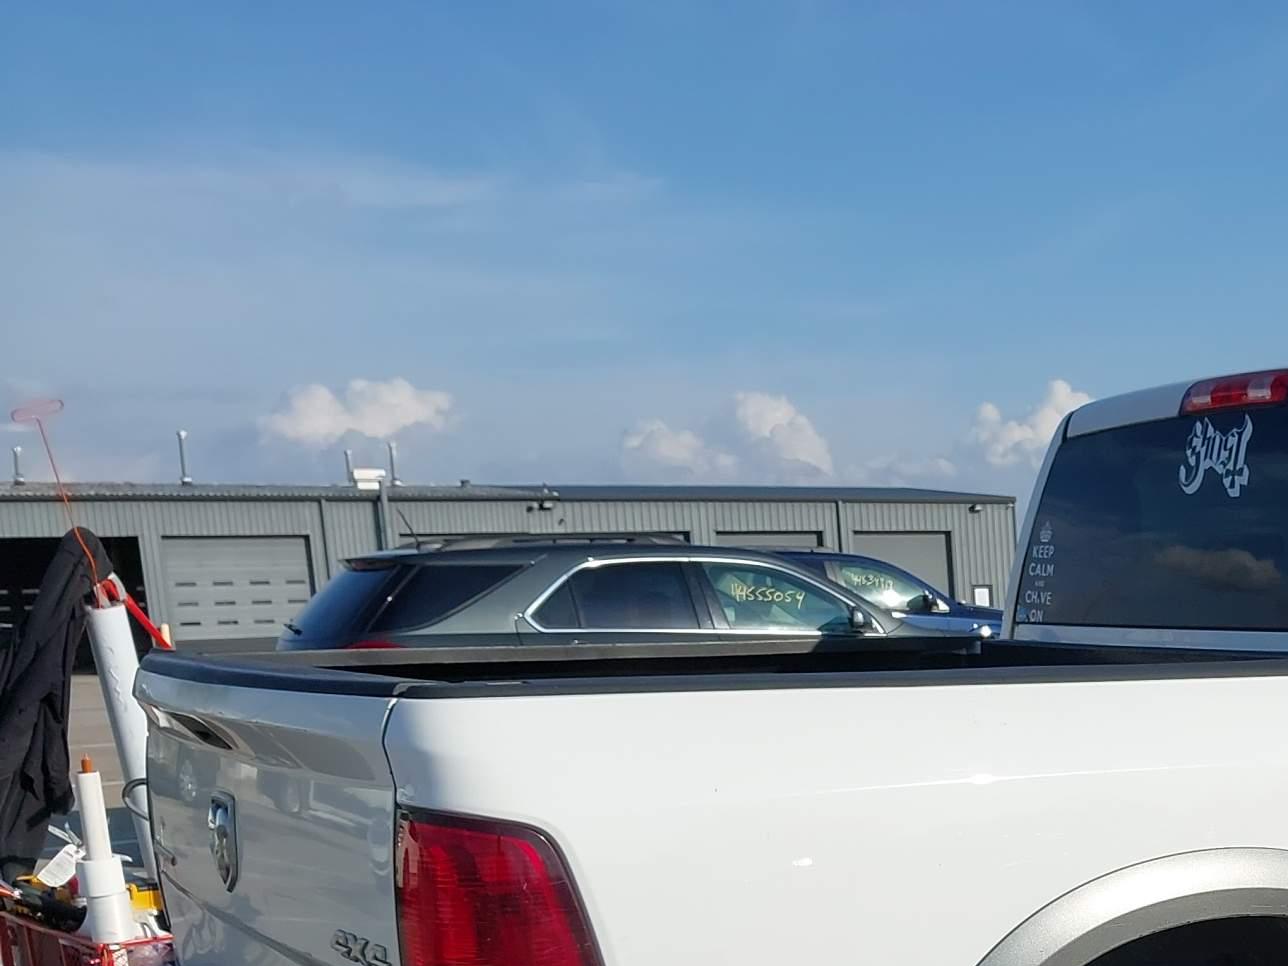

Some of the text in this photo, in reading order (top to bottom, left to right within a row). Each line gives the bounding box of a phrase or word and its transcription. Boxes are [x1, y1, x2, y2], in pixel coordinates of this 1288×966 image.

[1032, 545, 1055, 558] KEEP
[1028, 562, 1054, 576] CALM
[1029, 608, 1044, 622] ON
